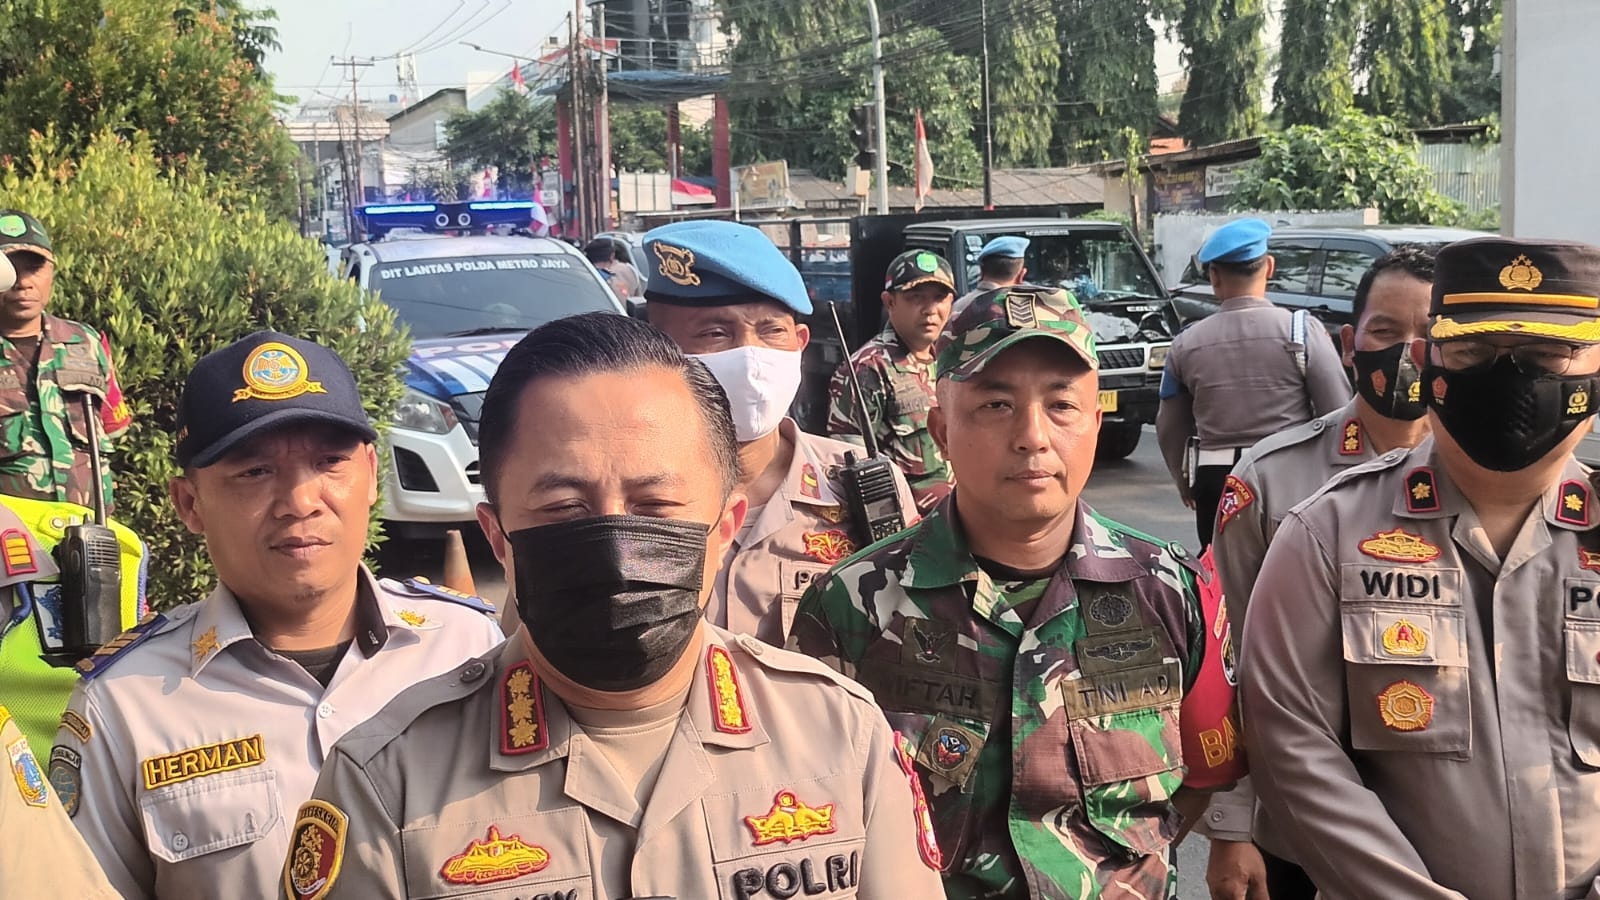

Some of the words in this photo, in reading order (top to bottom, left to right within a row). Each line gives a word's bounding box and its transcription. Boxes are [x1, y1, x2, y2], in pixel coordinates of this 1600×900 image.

[380, 267, 402, 280] DIT
[404, 262, 454, 277] LANTAS
[454, 260, 496, 272] POLDA
[496, 258, 539, 270] METRO
[541, 258, 570, 270] JAYA
[412, 340, 520, 359] PO
[1360, 569, 1441, 600] WIDI
[1570, 586, 1600, 612] P
[1078, 680, 1129, 708] TNI
[1140, 673, 1171, 700] AD
[148, 737, 262, 785] HERMAN
[732, 849, 858, 900] POLRI
